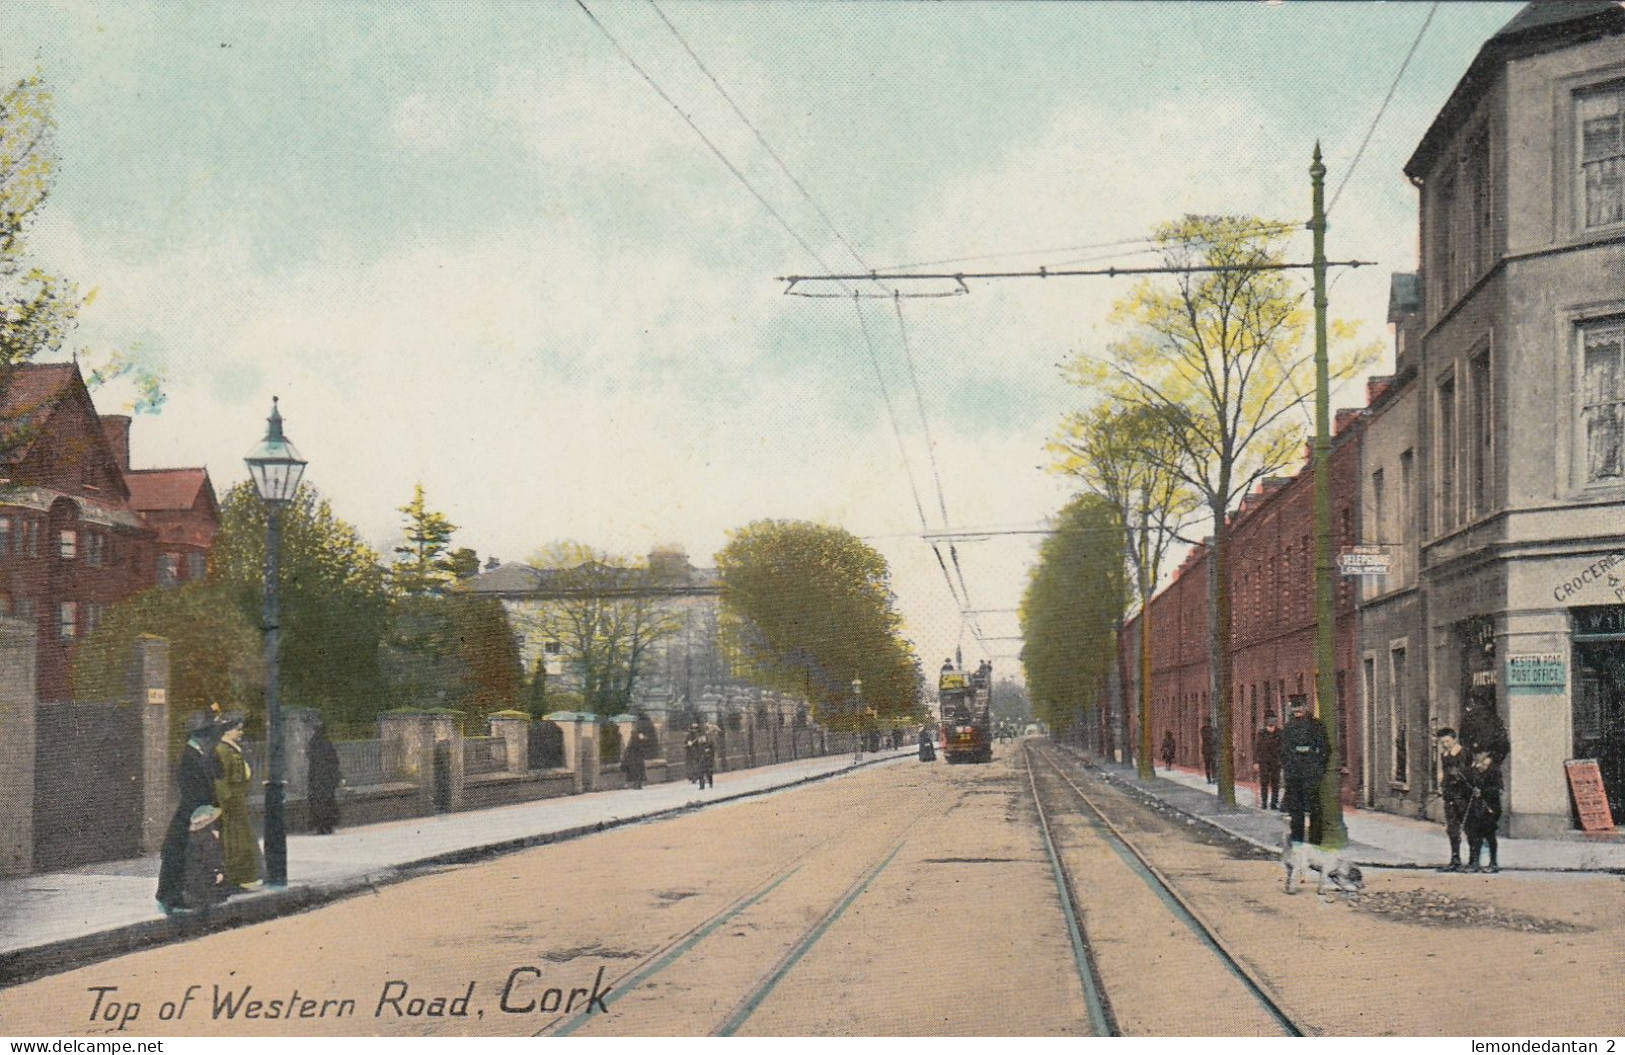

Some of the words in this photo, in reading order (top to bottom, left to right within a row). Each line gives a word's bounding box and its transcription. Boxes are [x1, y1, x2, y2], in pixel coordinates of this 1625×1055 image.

[1607, 574, 1620, 587] &
[1510, 655, 1541, 667] WESTERN
[1544, 654, 1561, 666] ROAD
[1512, 669, 1531, 681] POST
[1534, 668, 1559, 681] OFFICE
